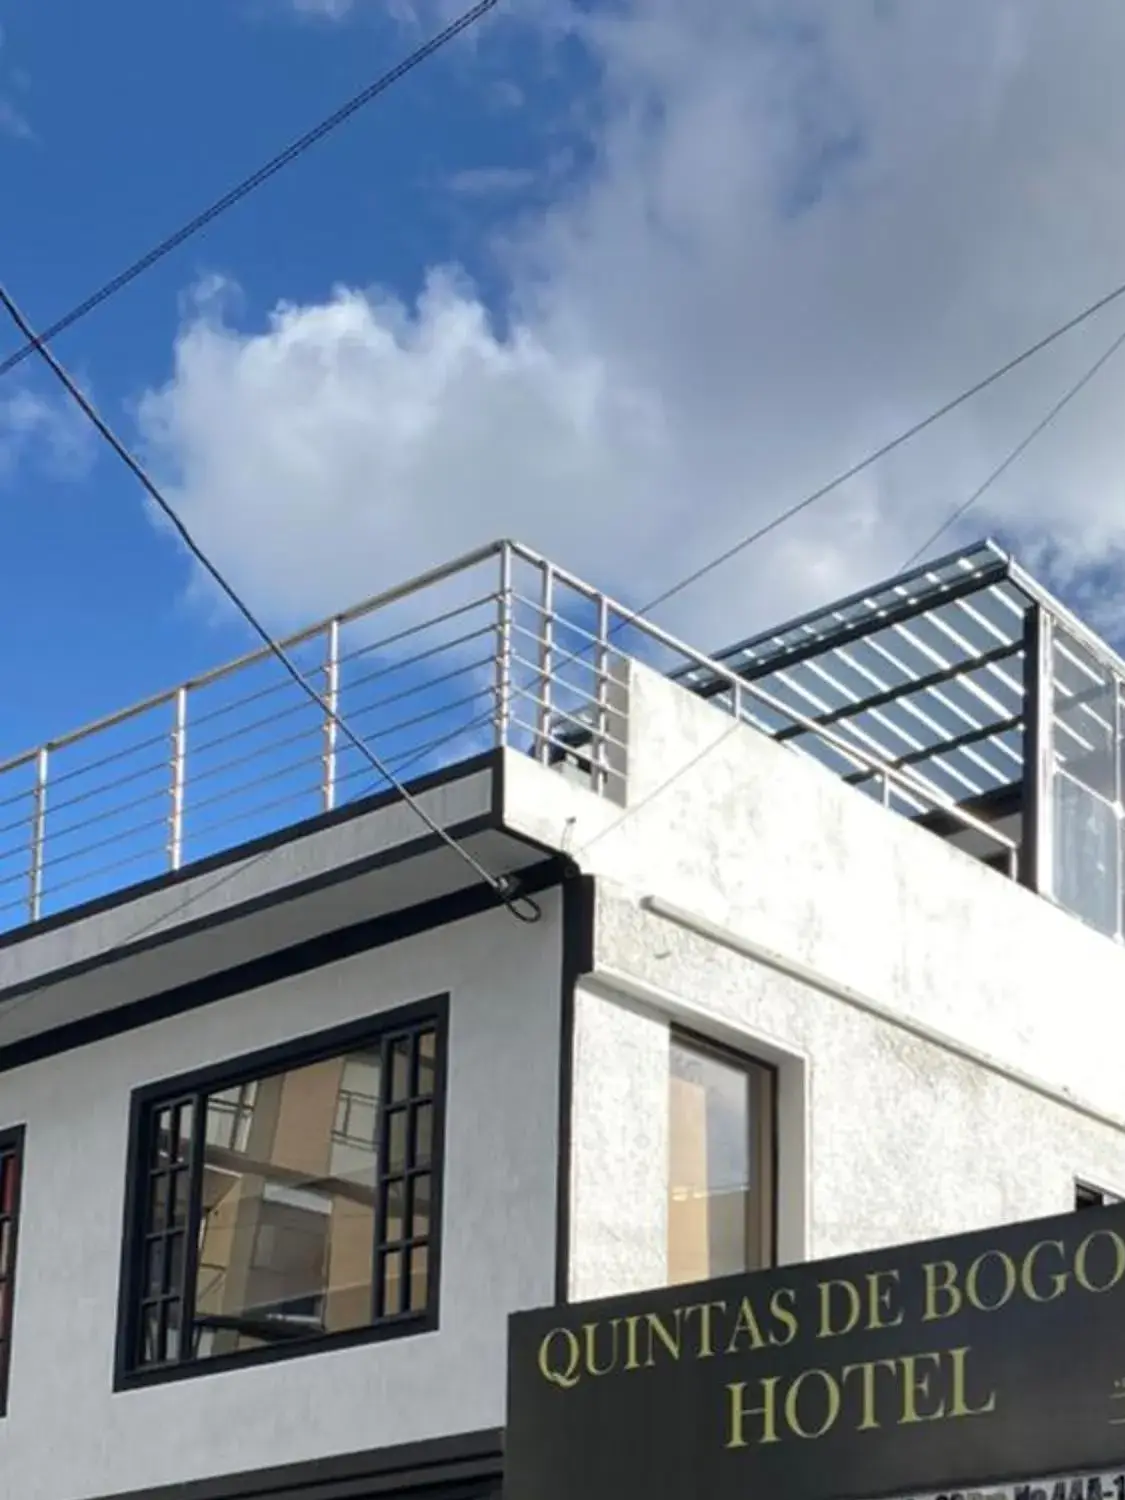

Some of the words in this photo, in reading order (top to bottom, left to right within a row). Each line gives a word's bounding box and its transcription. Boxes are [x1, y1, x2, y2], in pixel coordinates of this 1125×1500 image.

[538, 1287, 798, 1389] QUINTAS
[816, 1268, 902, 1339] DE
[724, 1347, 997, 1449] HOTEL
